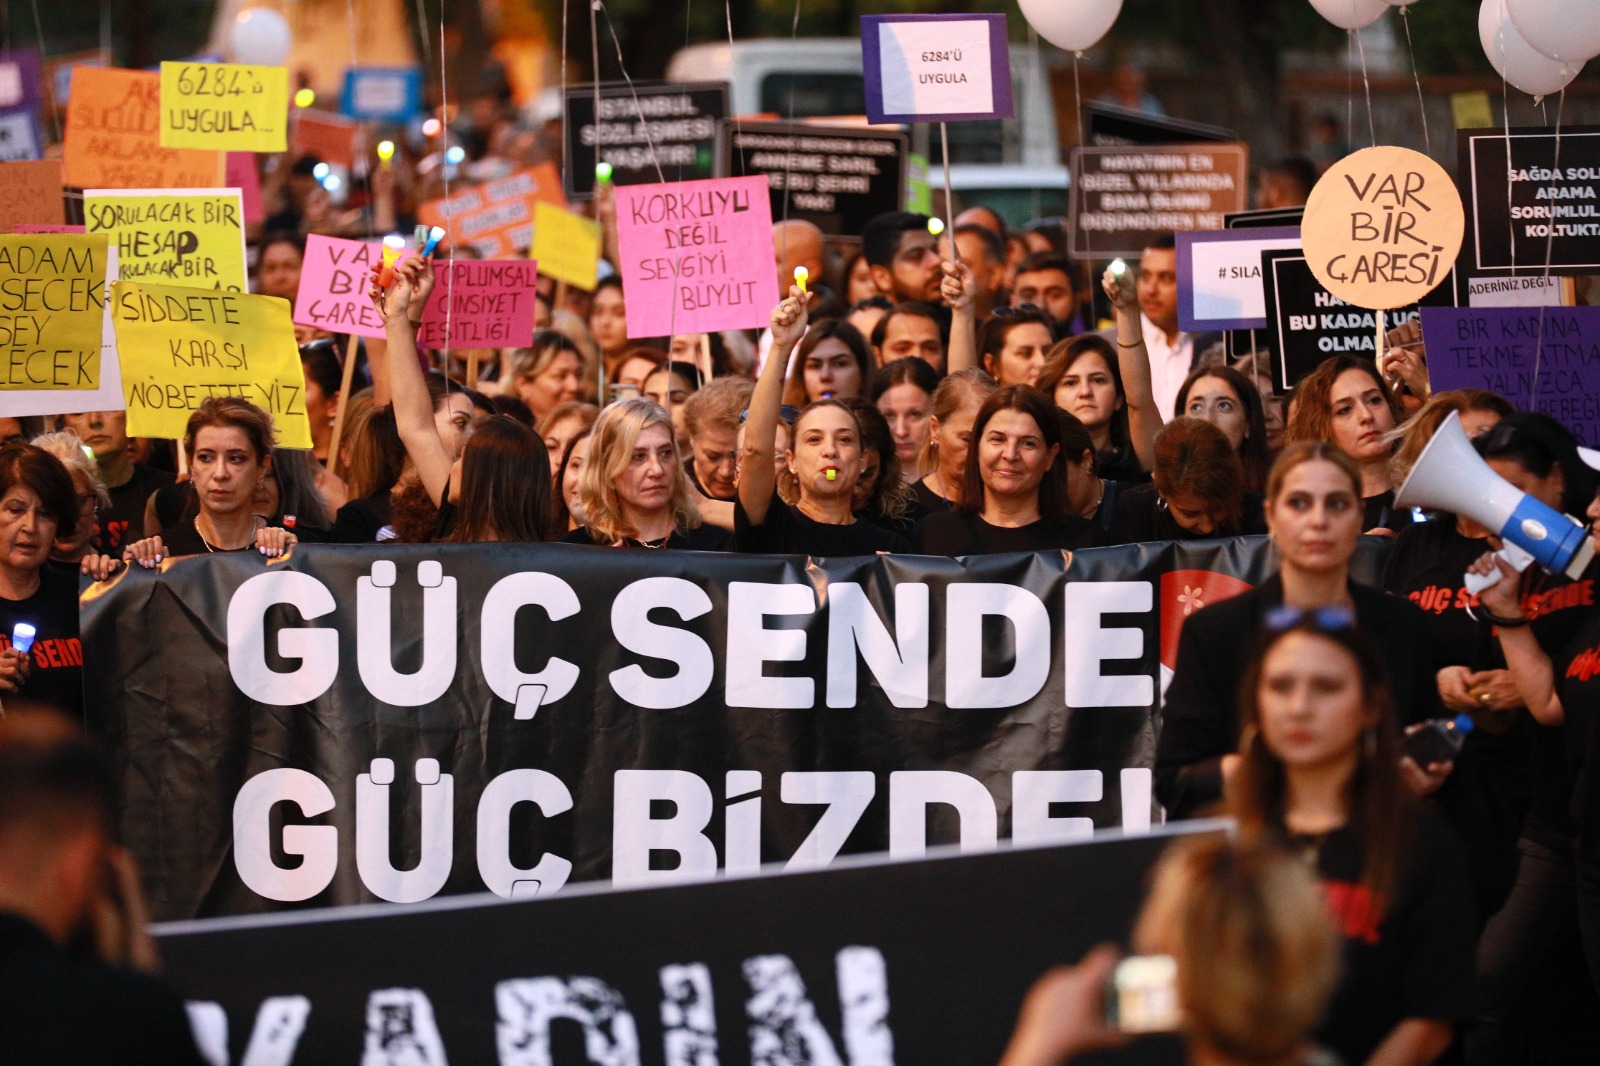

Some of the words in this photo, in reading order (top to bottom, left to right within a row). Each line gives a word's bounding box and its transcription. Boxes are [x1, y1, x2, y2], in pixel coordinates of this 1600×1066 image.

[921, 48, 962, 62] 6284'Ü
[919, 73, 968, 84] UYGULA
[1508, 165, 1565, 182] SAĞDA
[631, 189, 749, 225] KORKUYU
[1344, 171, 1432, 212] VAR
[1535, 186, 1597, 200] ARAMA
[89, 201, 196, 232] SORULACAK
[203, 199, 240, 229] BİR
[1351, 205, 1428, 247] BİR
[1511, 205, 1600, 219] SORUMLUL
[118, 230, 199, 266] HESAP
[664, 221, 728, 249] DEĞİL
[183, 257, 218, 277] BİR
[639, 249, 727, 280] SEVGİYİ
[1326, 245, 1444, 286] ÇARESİ
[681, 277, 757, 311] BÜYÜT
[1289, 315, 1317, 331] BU
[1456, 313, 1490, 341] BİR
[1501, 315, 1582, 339] KADINA
[169, 338, 248, 371] KARŞI
[1318, 336, 1376, 352] OLMA
[1449, 345, 1525, 368] TEKME
[0, 350, 95, 386] ECEK
[226, 559, 582, 721] GÜÇ
[607, 575, 1154, 709] SENDE
[232, 757, 574, 905] GÜÇ
